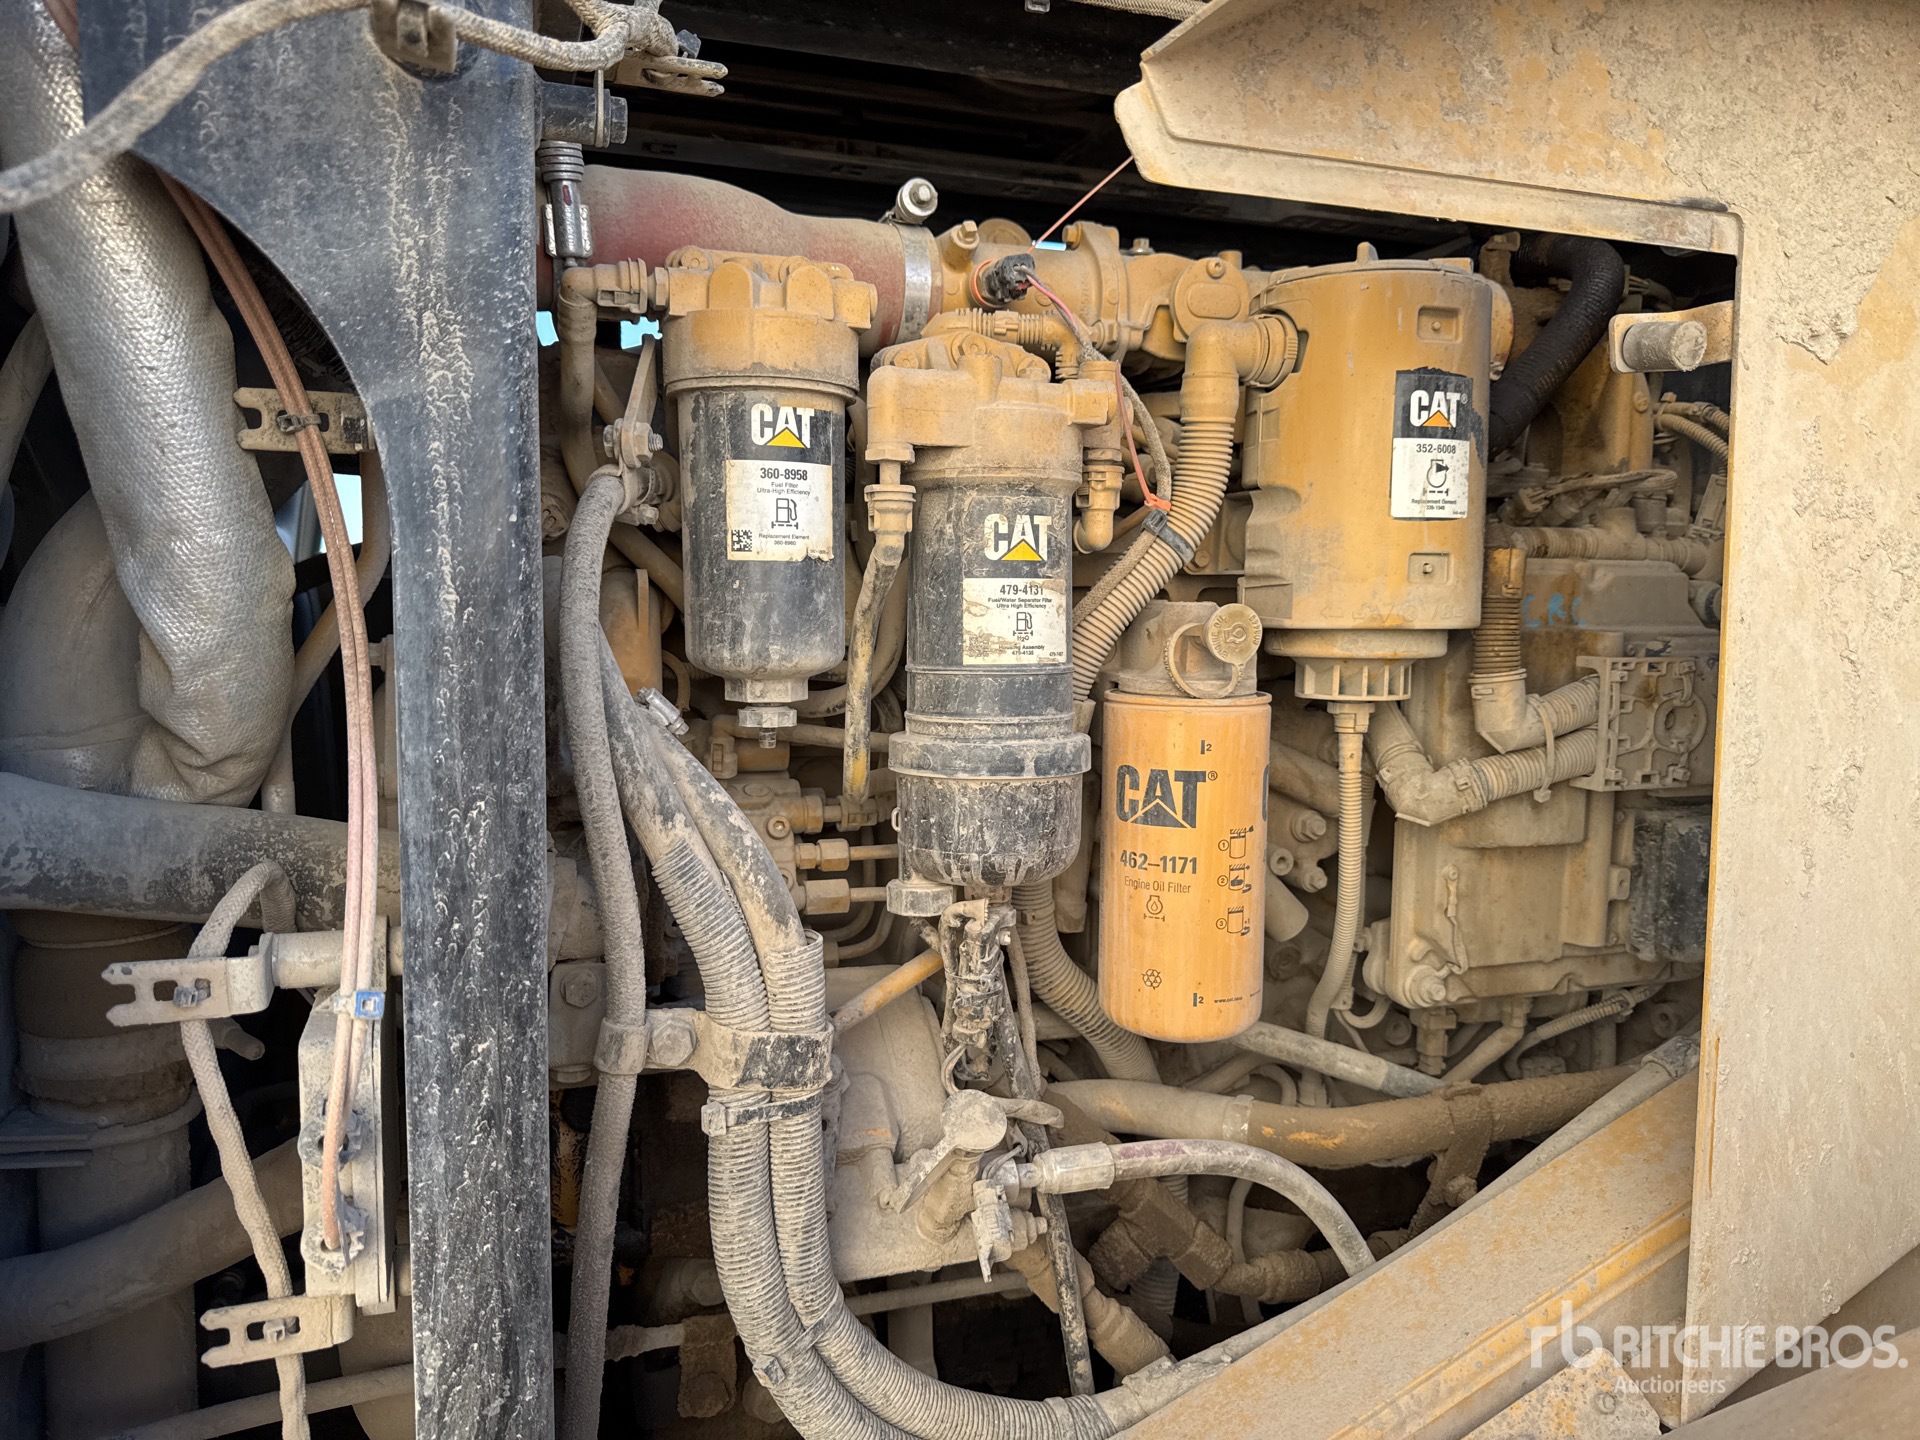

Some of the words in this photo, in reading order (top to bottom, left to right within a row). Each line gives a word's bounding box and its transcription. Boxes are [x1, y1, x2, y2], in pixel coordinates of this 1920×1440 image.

[751, 403, 815, 448] CAT
[1416, 444, 1456, 454] 352-6008
[760, 467, 808, 481] 360-8958
[787, 488, 811, 497] Efficiency
[758, 532, 791, 540] Replacement
[984, 513, 1052, 561] CAT
[1000, 584, 1044, 596] 479-4131
[1022, 644, 1045, 652] Assembly
[1120, 849, 1197, 875] 462-1171
[1124, 875, 1150, 890] Engine
[1152, 880, 1165, 892] Oil
[1167, 881, 1191, 893] Filter
